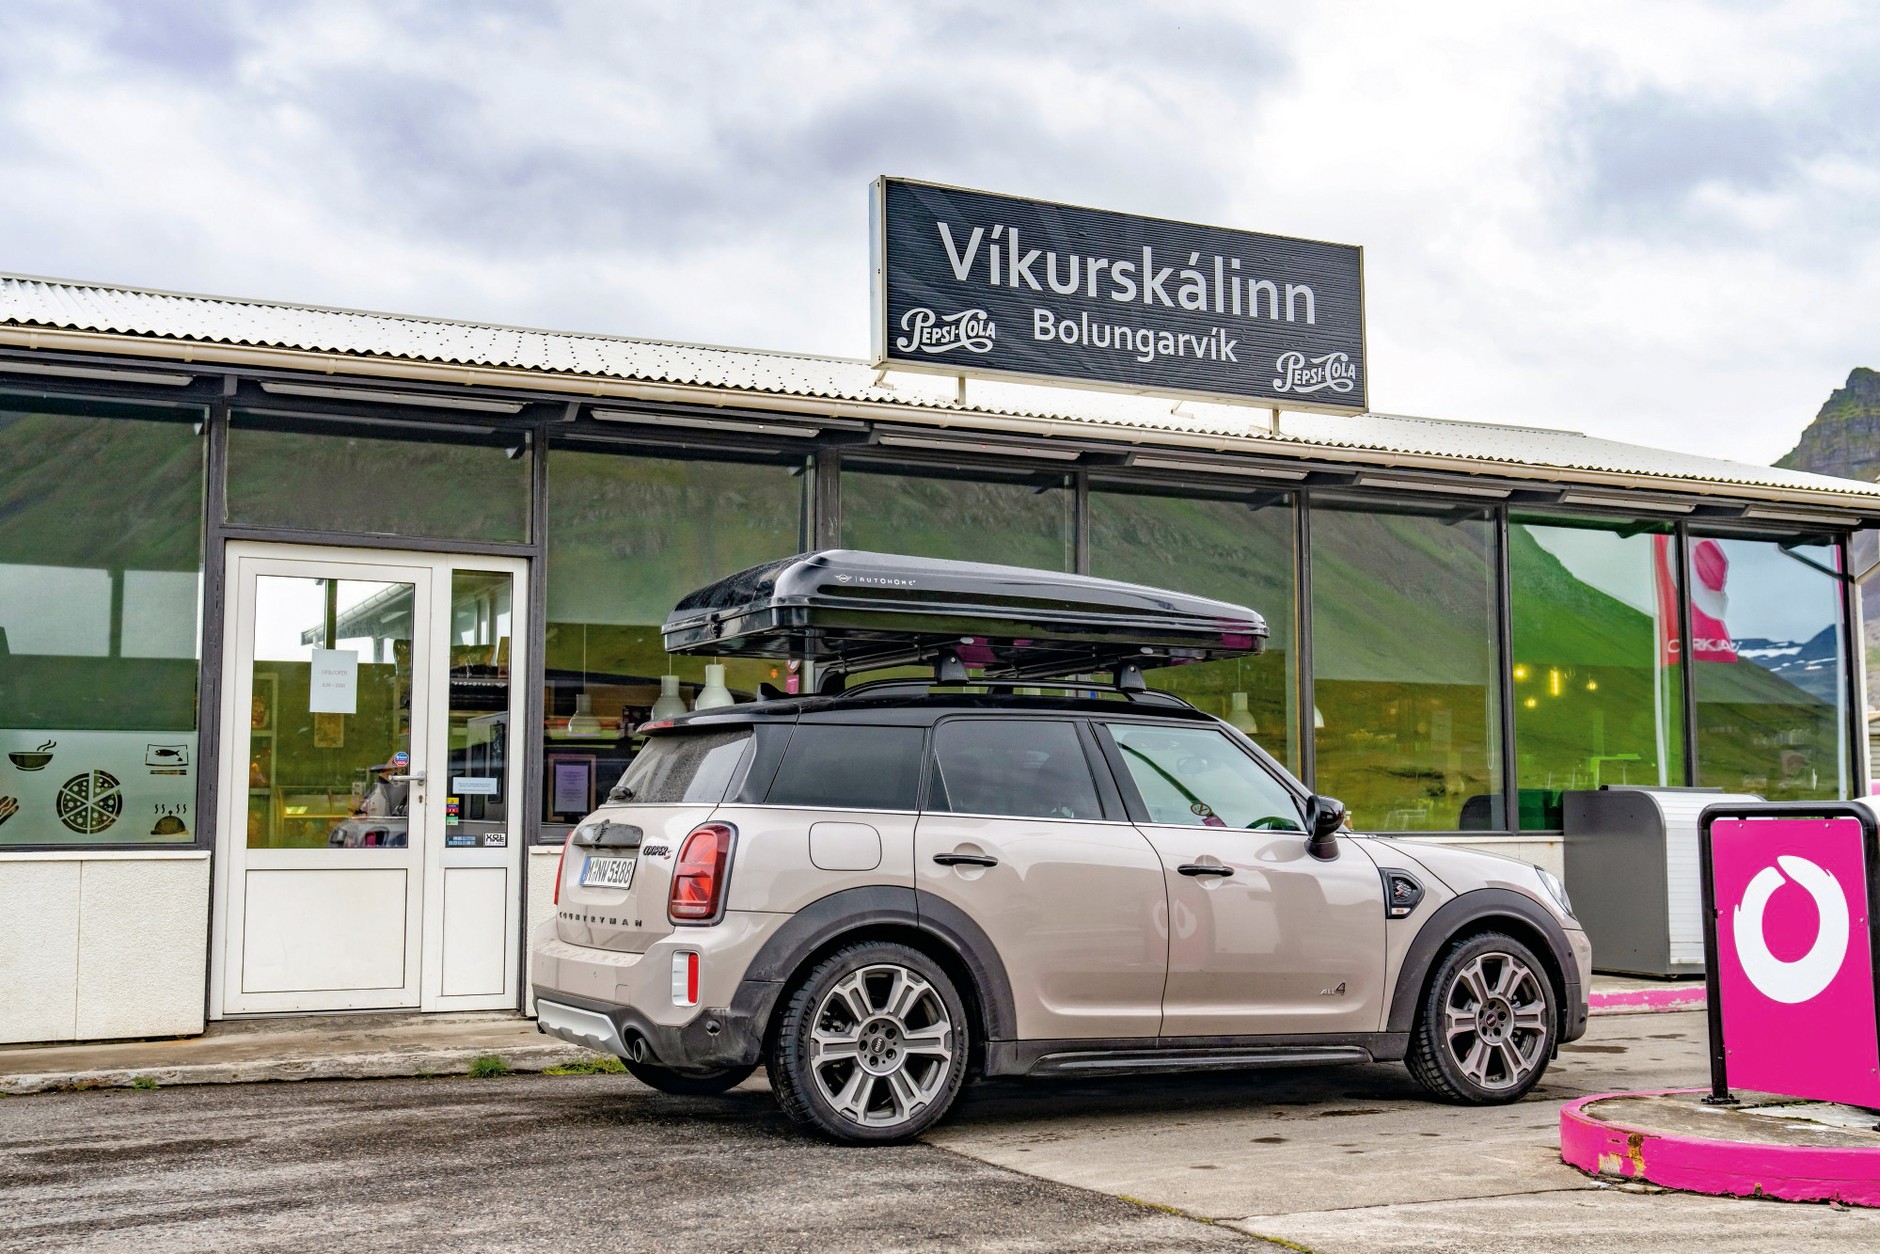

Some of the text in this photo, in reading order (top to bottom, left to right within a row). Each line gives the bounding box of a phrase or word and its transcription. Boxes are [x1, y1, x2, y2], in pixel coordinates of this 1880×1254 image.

[936, 221, 1316, 325] Víkurskálinn
[1034, 307, 1238, 363] Bolungarvík
[559, 911, 643, 927] COUNTRYMAN
